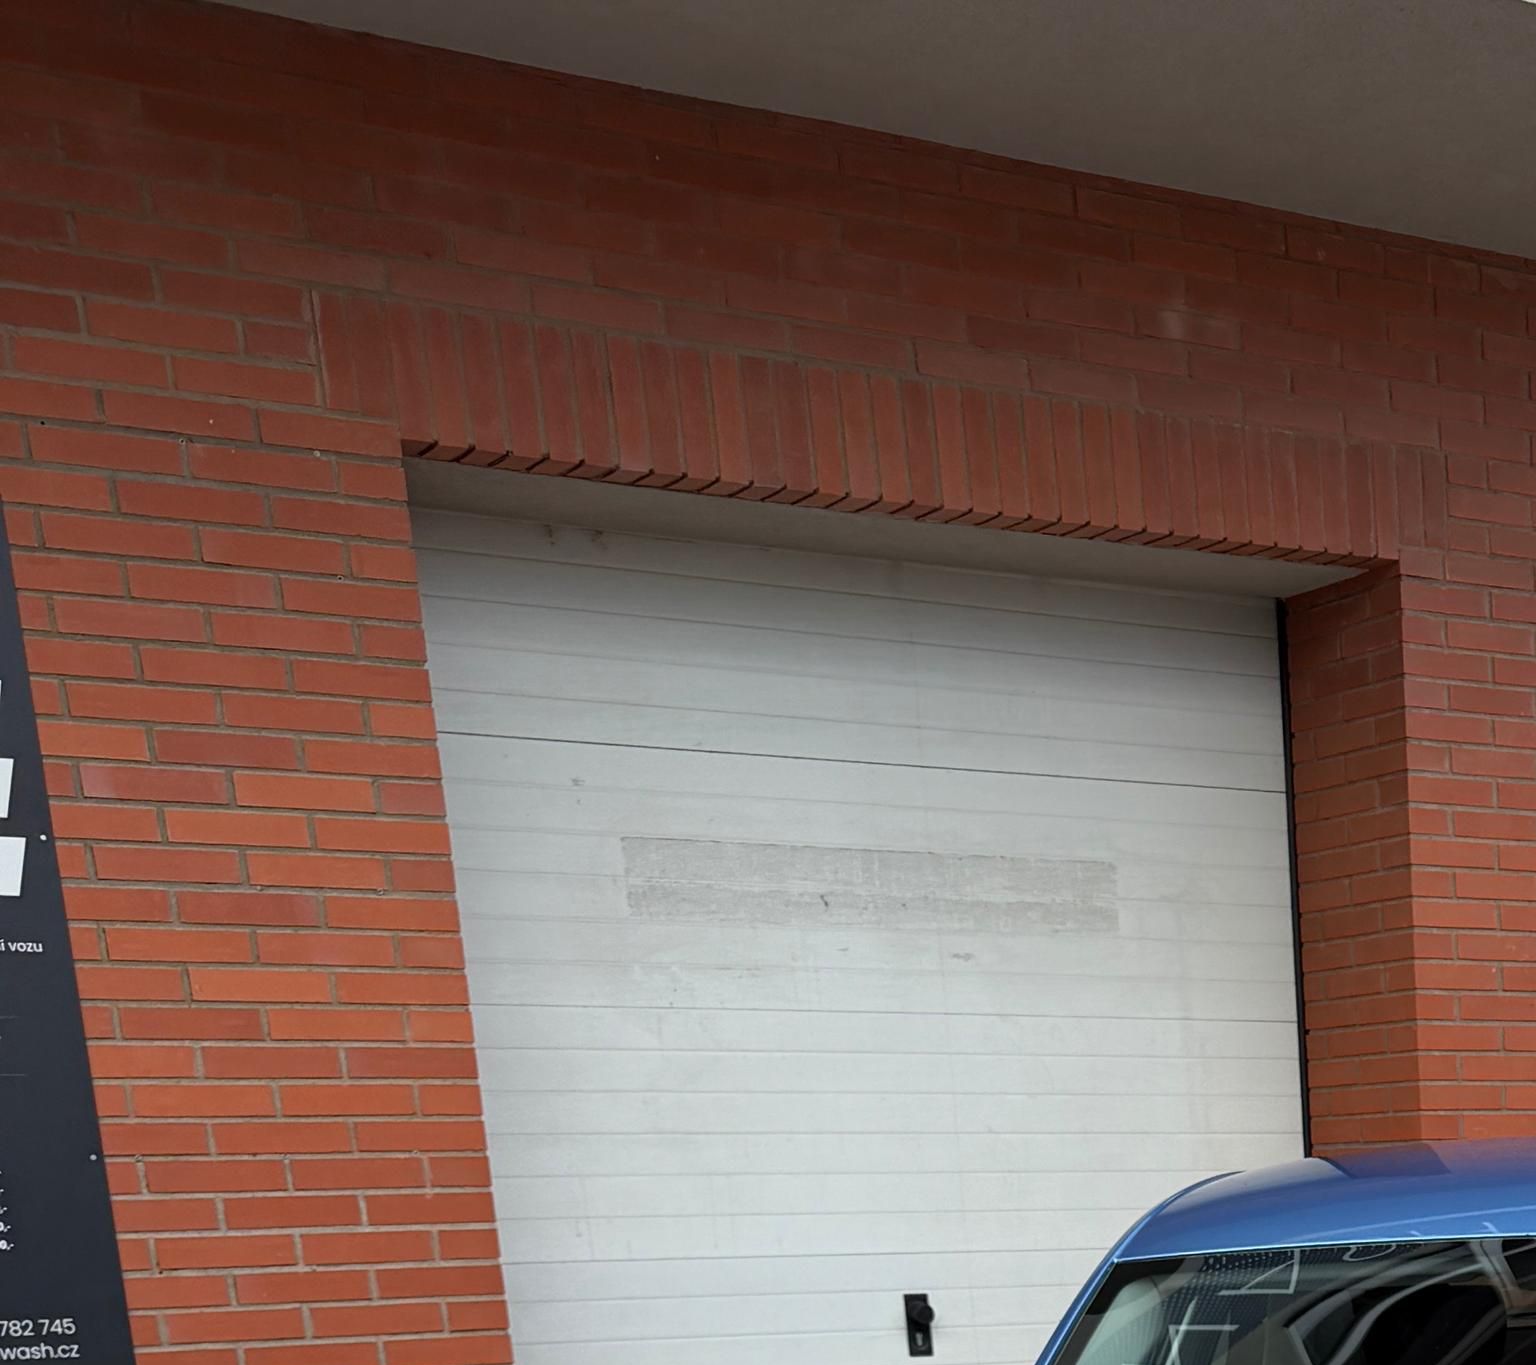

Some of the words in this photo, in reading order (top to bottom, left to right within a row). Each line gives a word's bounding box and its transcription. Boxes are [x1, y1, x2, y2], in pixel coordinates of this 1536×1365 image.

[7, 941, 43, 953] vozu
[0, 1319, 35, 1337] 782
[37, 1318, 76, 1335] 745
